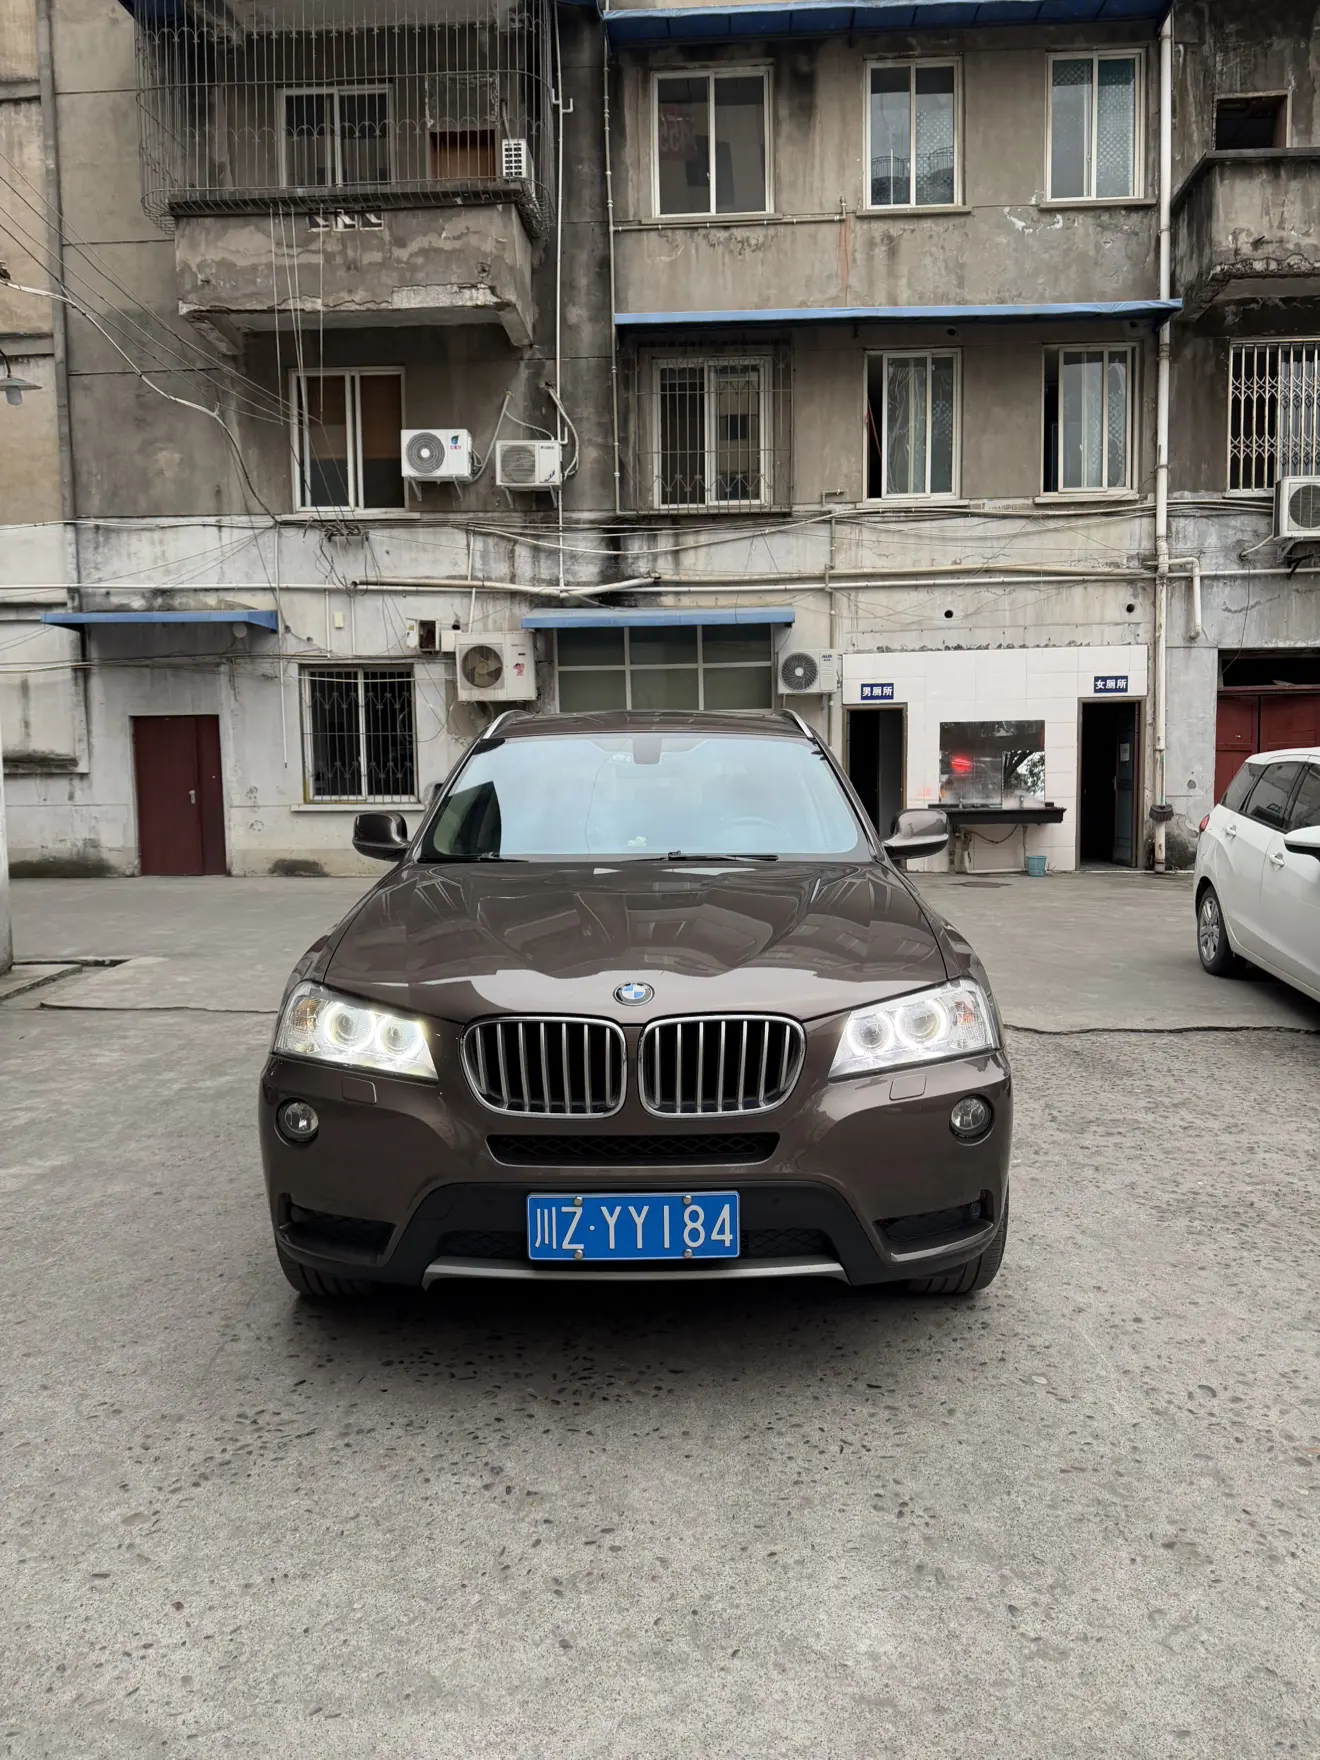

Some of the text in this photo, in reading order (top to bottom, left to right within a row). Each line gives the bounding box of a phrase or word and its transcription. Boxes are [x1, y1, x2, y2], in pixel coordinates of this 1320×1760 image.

[1095, 678, 1127, 690] 女厕所
[862, 685, 893, 697] 男厕所
